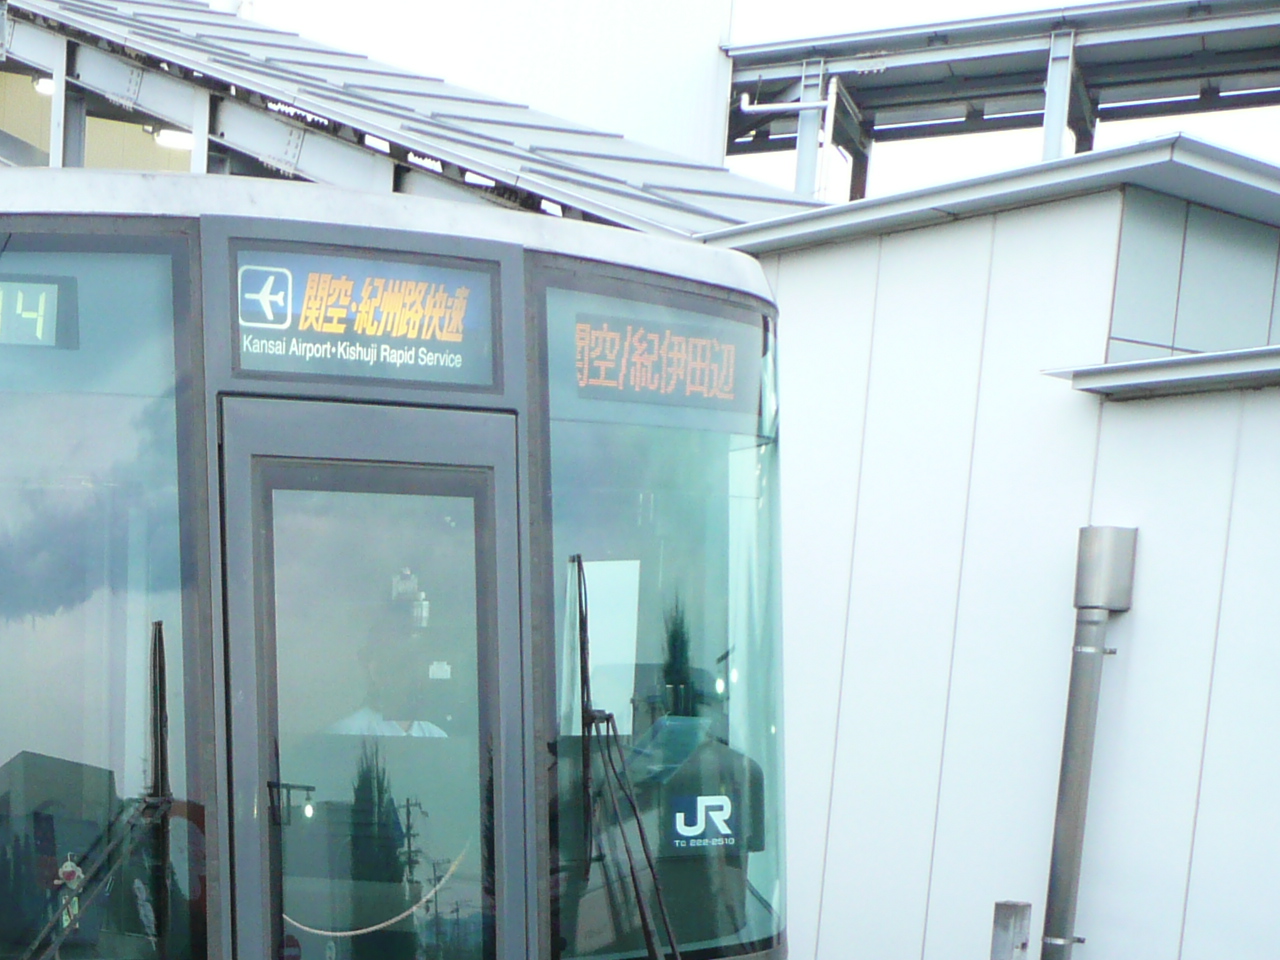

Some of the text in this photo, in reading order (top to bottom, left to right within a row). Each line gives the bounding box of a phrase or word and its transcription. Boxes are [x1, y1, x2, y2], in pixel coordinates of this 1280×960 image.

[243, 334, 286, 355] Kansai
[380, 344, 416, 367] Rapid
[418, 347, 462, 368] Service
[675, 795, 733, 836] JR
